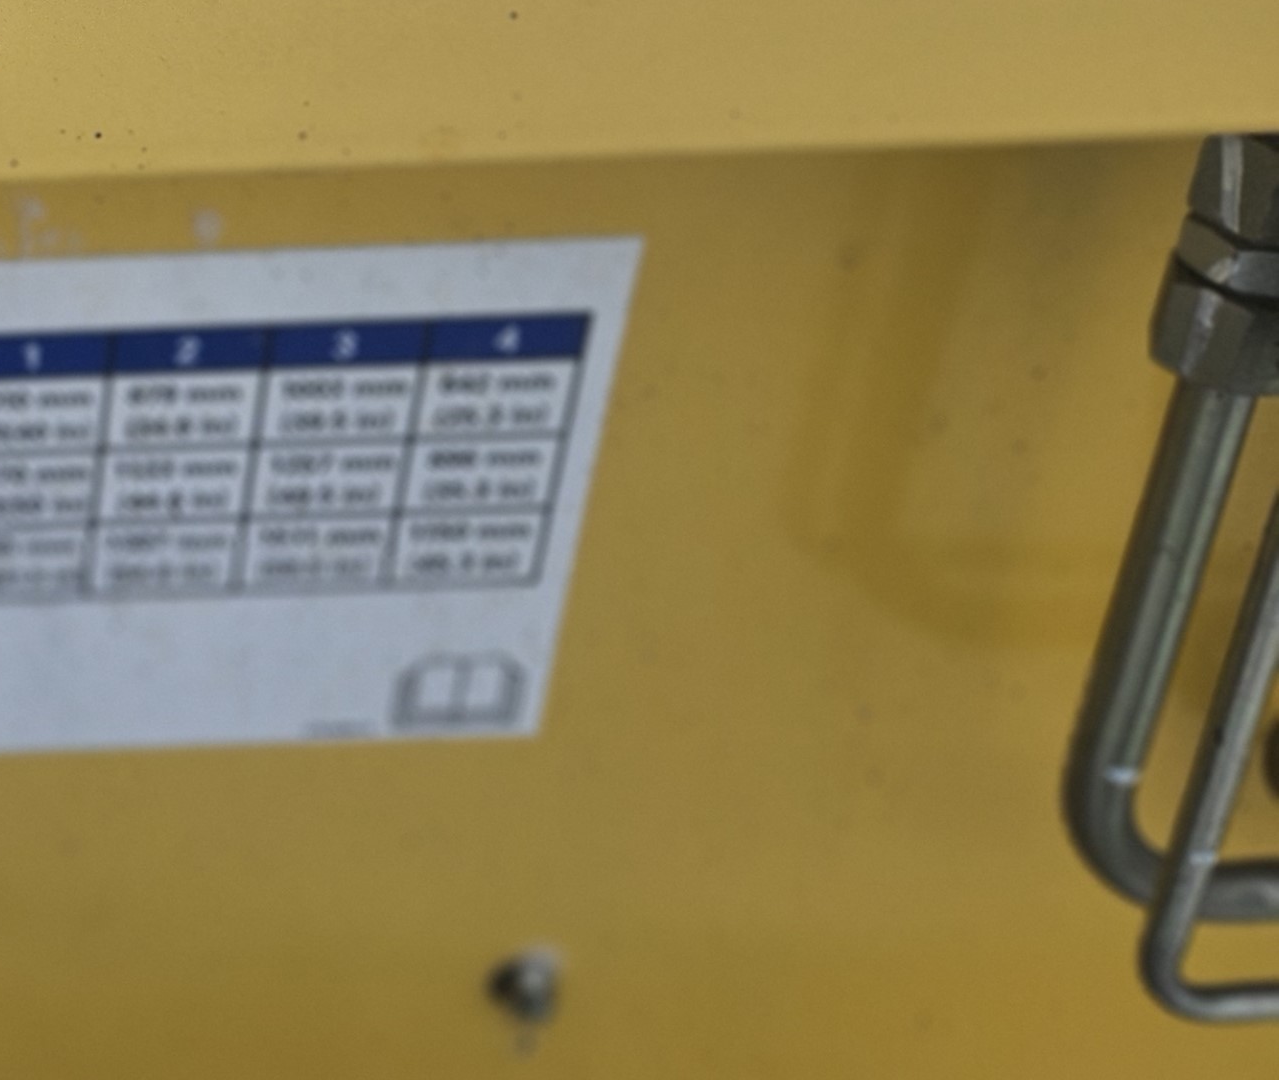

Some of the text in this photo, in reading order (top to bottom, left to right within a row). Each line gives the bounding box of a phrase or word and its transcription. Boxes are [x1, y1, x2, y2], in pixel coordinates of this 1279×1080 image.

[174, 335, 202, 364] 2
[333, 328, 359, 361] 3
[495, 324, 520, 353] 4
